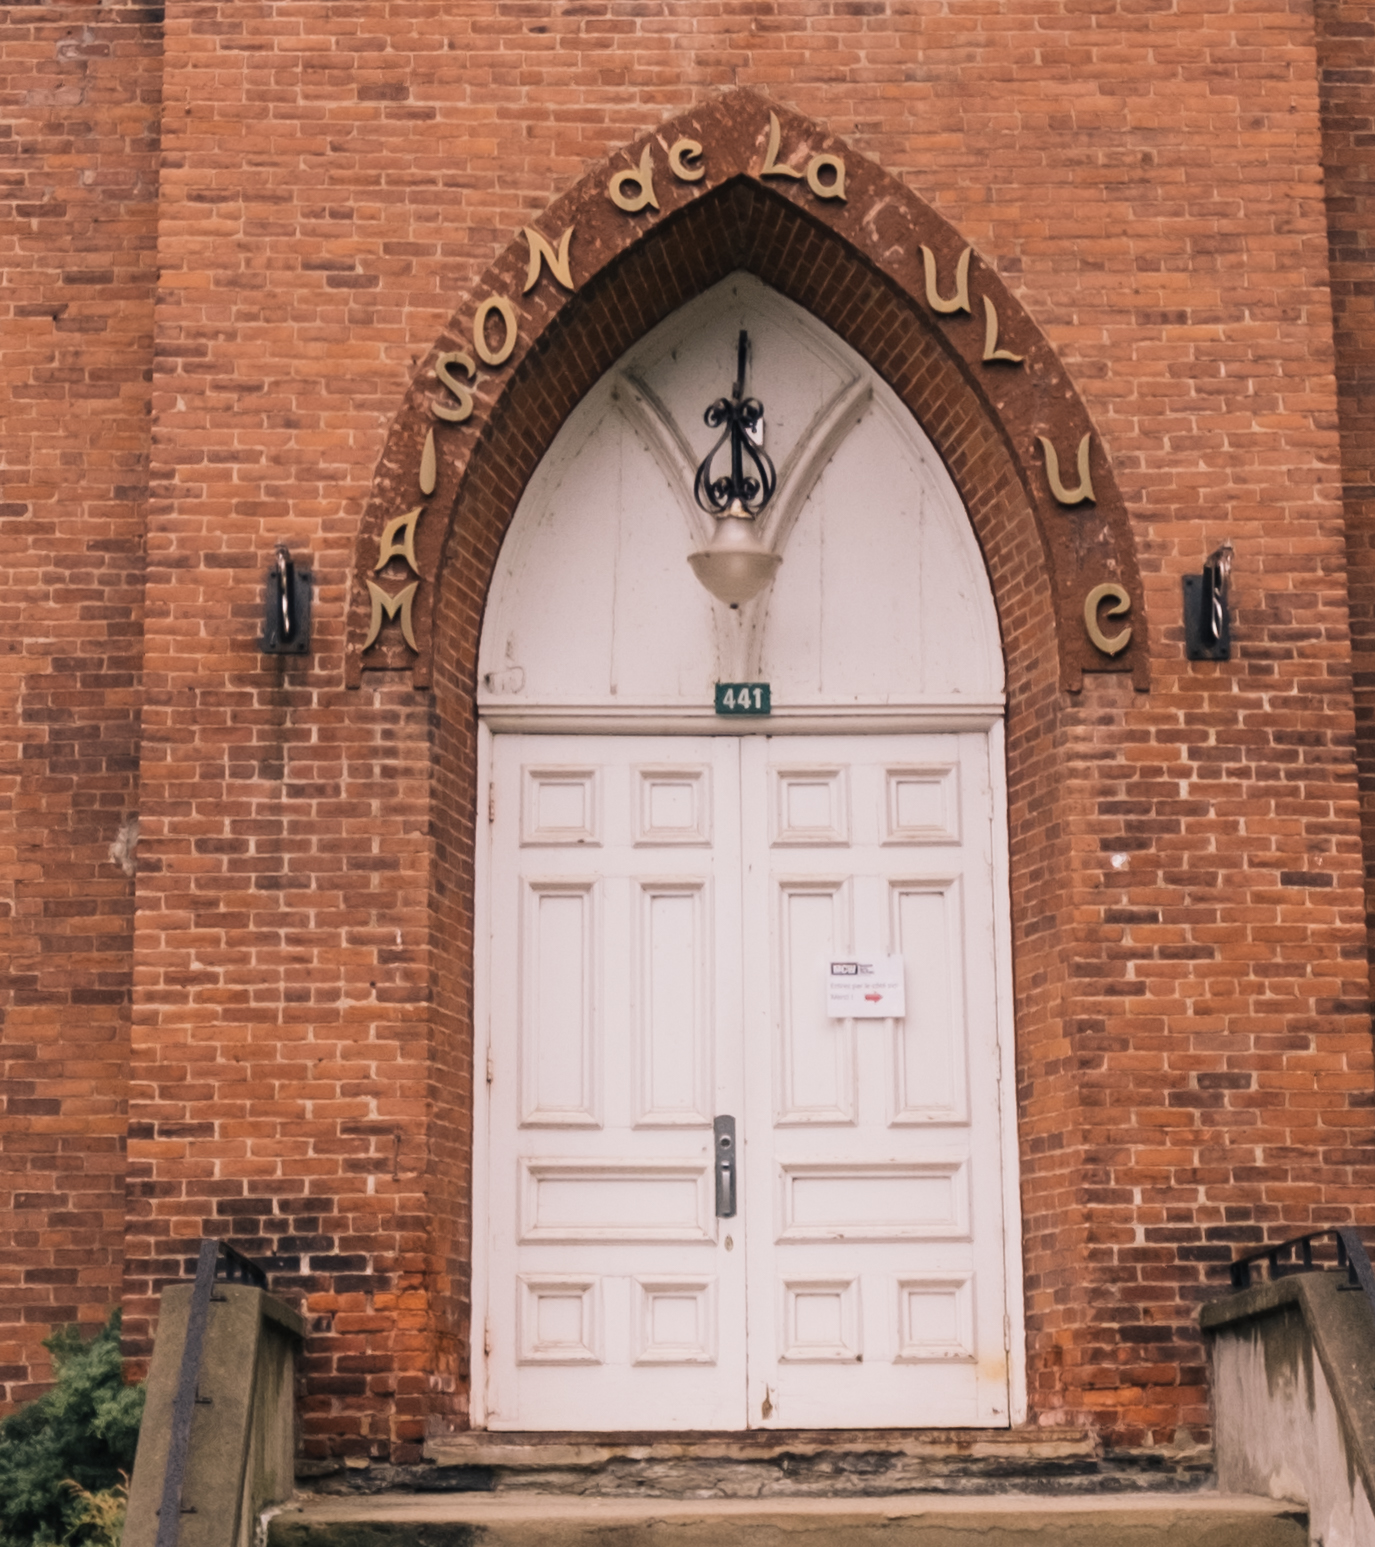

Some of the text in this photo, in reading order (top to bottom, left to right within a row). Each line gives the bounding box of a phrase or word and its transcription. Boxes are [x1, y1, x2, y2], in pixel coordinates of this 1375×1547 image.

[362, 225, 575, 654] MAISON
[609, 139, 707, 214] de
[722, 687, 763, 710] 441
